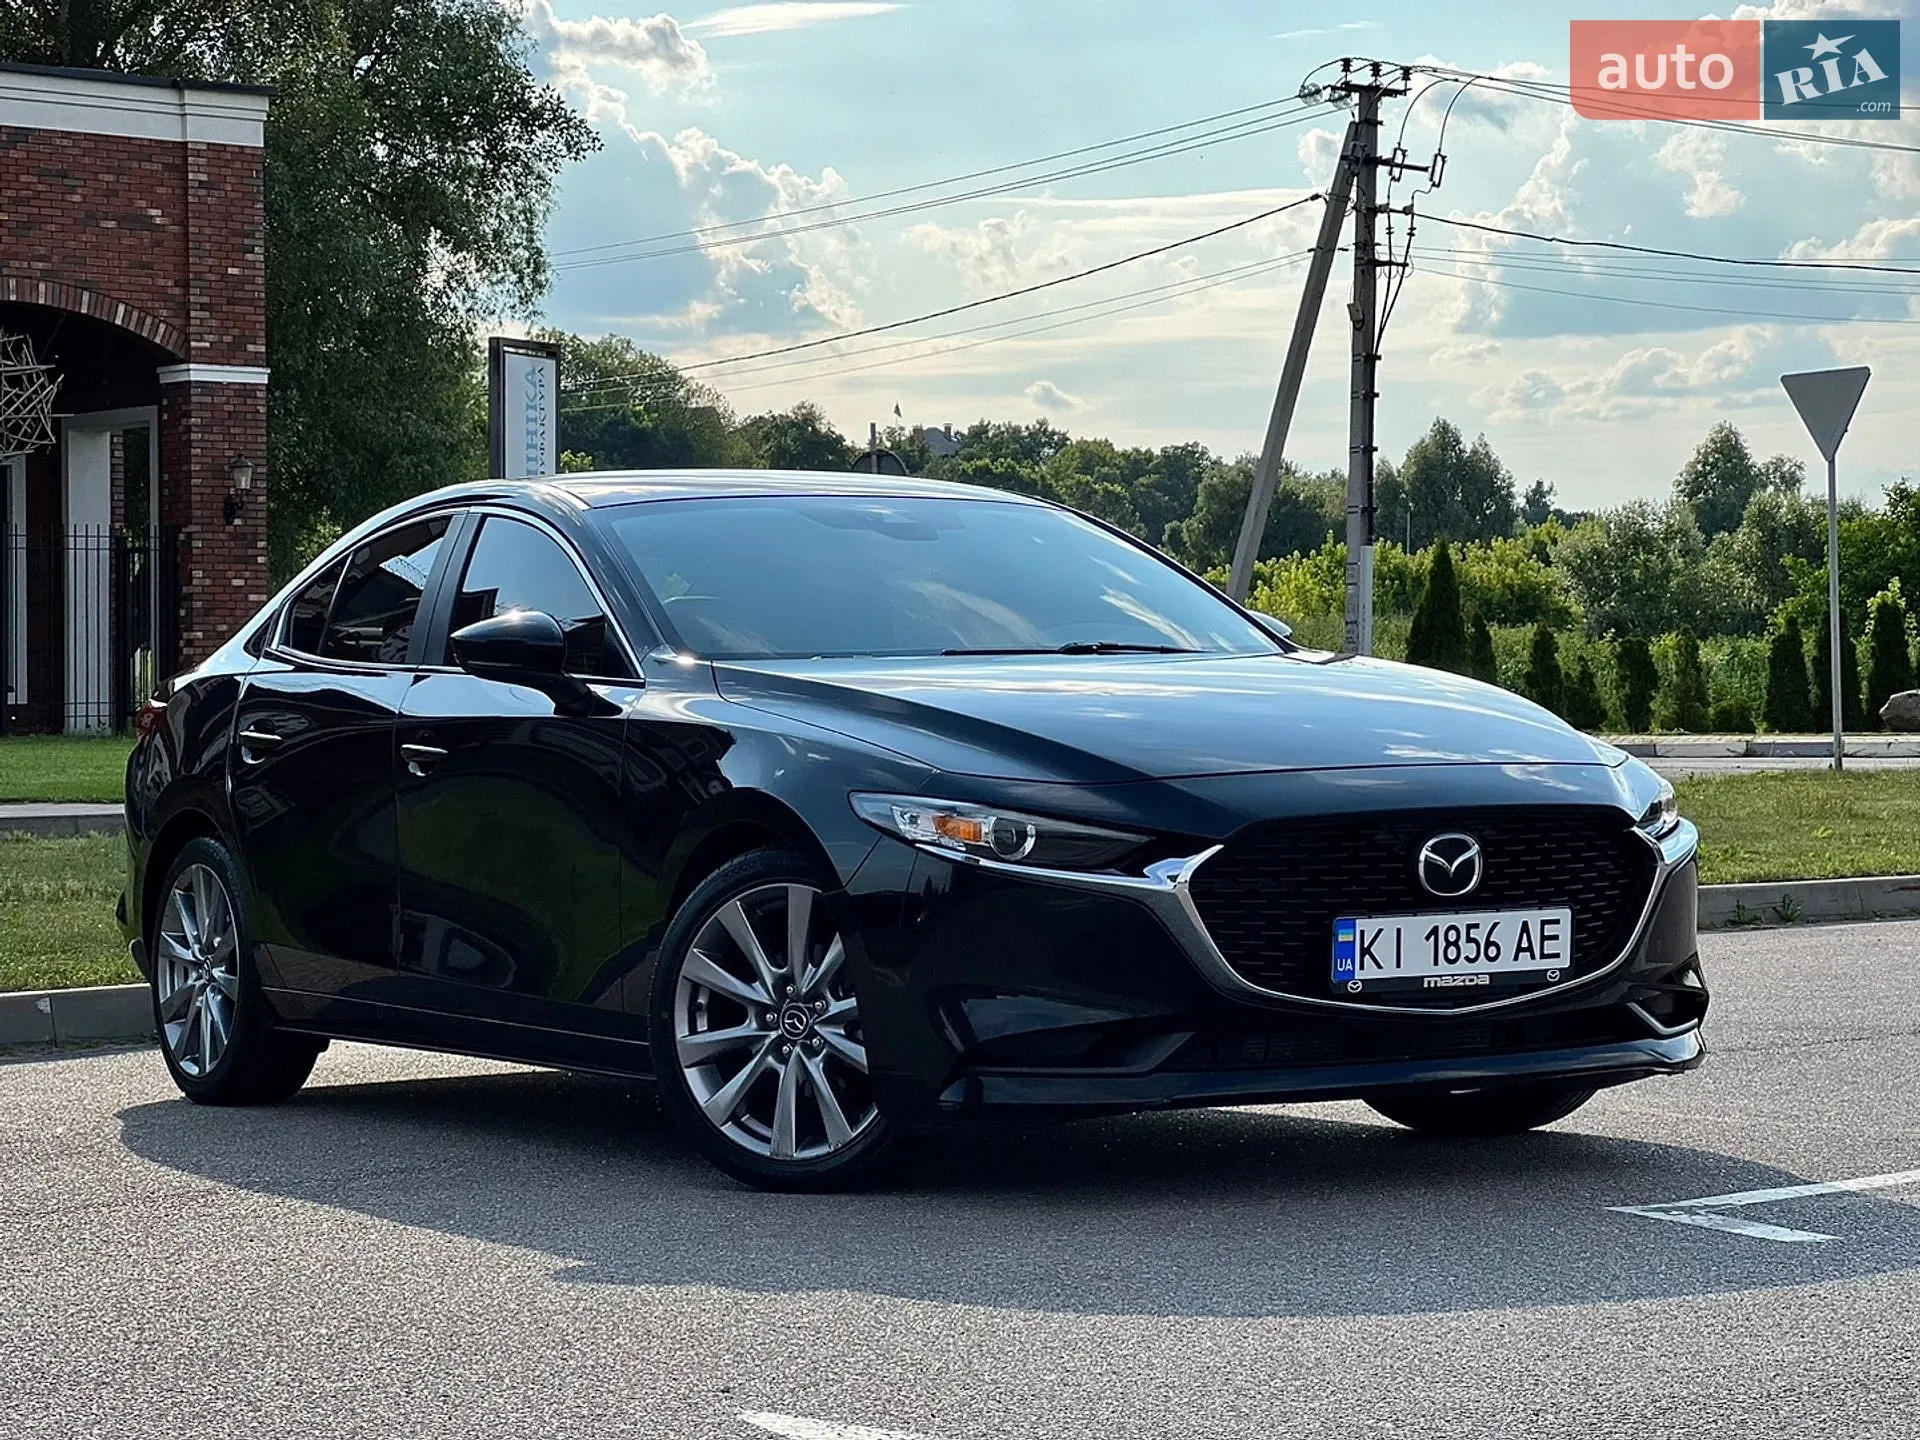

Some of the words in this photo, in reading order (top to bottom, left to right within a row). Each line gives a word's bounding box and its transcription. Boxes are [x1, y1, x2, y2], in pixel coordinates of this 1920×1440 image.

[1358, 927, 1402, 971] KI
[1424, 921, 1502, 967] 1856
[1512, 918, 1562, 962] AE
[1337, 958, 1354, 972] UA
